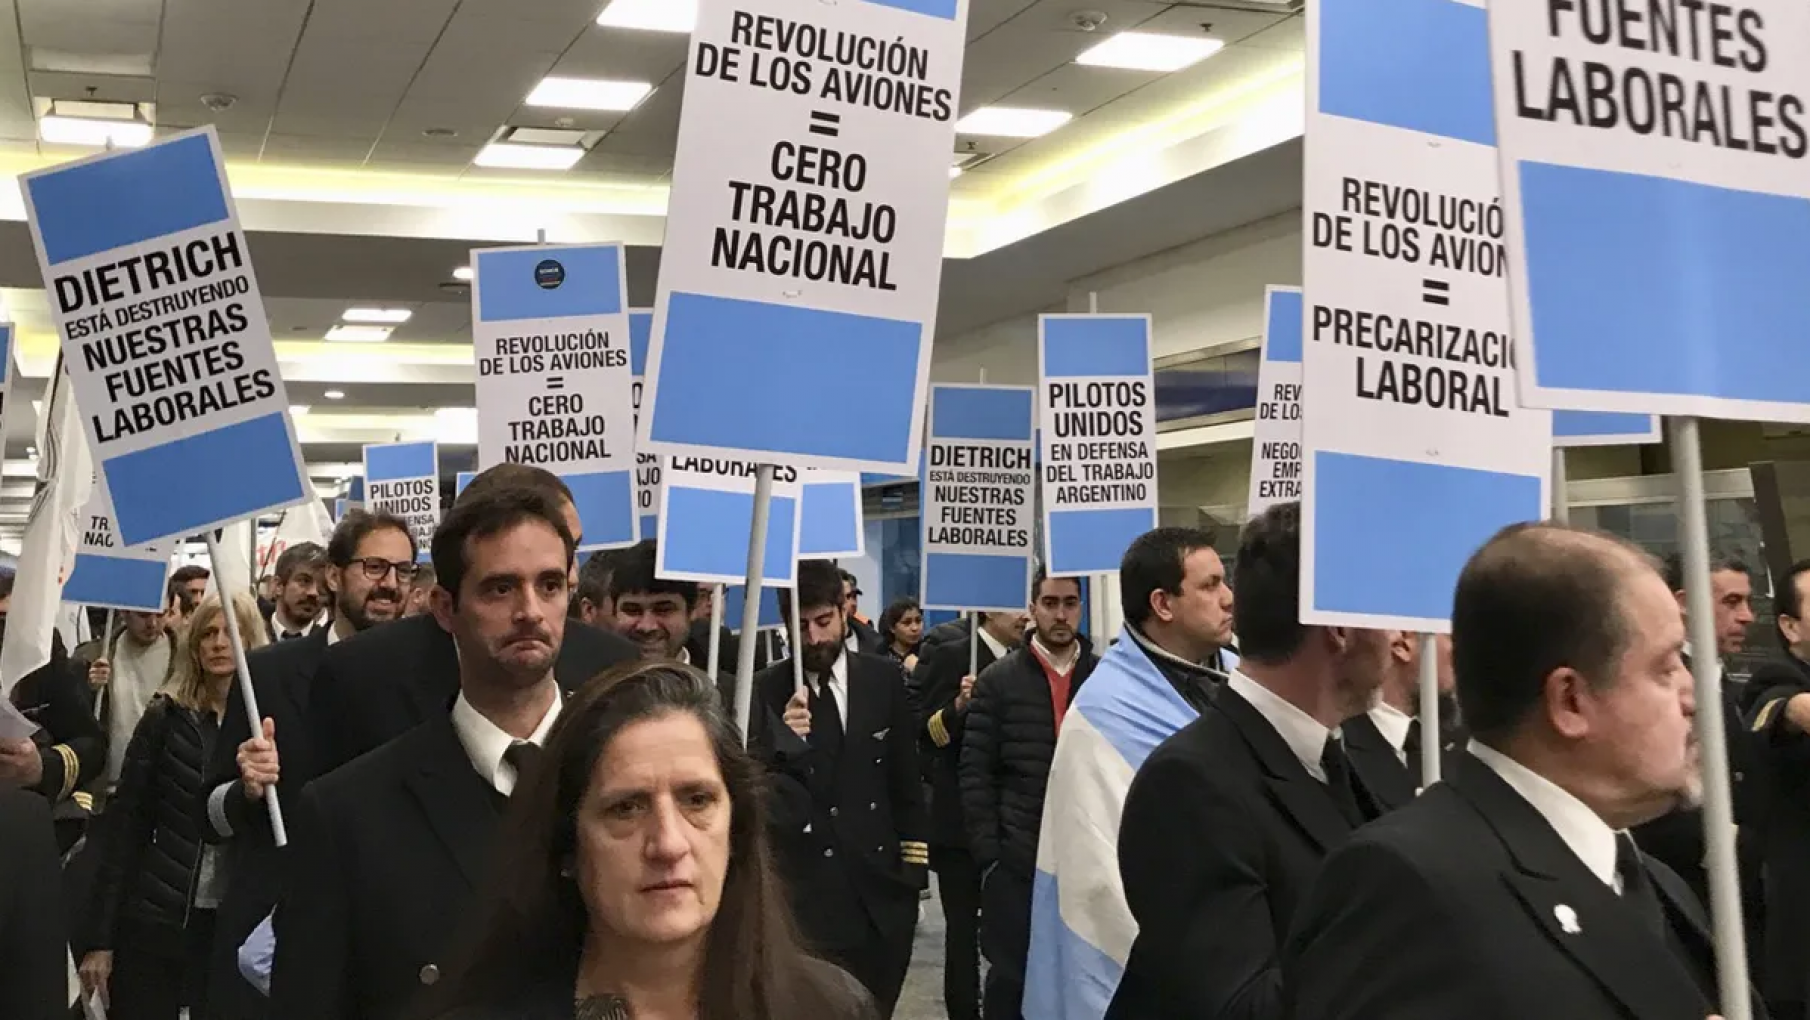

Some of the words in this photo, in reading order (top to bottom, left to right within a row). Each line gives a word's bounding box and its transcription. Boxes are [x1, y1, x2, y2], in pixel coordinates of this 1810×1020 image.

[731, 10, 929, 81] REVOLUCIÓN
[1547, 0, 1767, 73] FUENTES
[695, 42, 741, 82] DE
[749, 52, 812, 95] LOS
[820, 67, 952, 122] AVIONES
[1512, 50, 1808, 159] LABORALES
[771, 141, 867, 193] CERO
[729, 180, 896, 244] TRABAJO
[1313, 212, 1352, 251] DE
[1364, 221, 1420, 263] LOS
[54, 231, 243, 314] DIETRICH
[711, 227, 897, 291] NACIONAL
[65, 308, 113, 340] ESTÁ
[115, 275, 249, 326] DESTRUYENDO
[82, 303, 248, 372] NUESTRAS
[495, 328, 609, 355] REVOLUCIÓN
[105, 341, 244, 403] FUENTES
[480, 357, 503, 376] DE
[510, 354, 544, 373] LOS
[550, 349, 627, 371] AVIONES
[1049, 381, 1147, 408] PILOTOS
[1356, 356, 1509, 418] LABORAL
[92, 369, 275, 444] LABORALES
[528, 393, 583, 417] CERO
[1260, 402, 1278, 420] DE
[1282, 403, 1302, 420] LO
[508, 415, 605, 441] TRABAJO
[1054, 410, 1143, 438] UNIDOS
[505, 438, 611, 464] NACIONAL
[930, 445, 1031, 469] DIETRICH
[1051, 444, 1072, 462] EN
[1077, 441, 1148, 460] DEFENSA
[1261, 442, 1302, 460] NEGO
[671, 456, 797, 483] LABORAES
[929, 469, 955, 482] ESTÁ
[957, 471, 1031, 485] DESTRUYENDO
[1047, 464, 1077, 483] DEL
[1082, 462, 1153, 481] TRABAJO
[370, 479, 434, 499] PILOTOS
[935, 485, 1025, 506] NUESTRAS
[1056, 484, 1146, 504] ARGENTINO
[91, 515, 110, 530] TR
[941, 507, 1017, 526] FUENTES
[928, 526, 1028, 548] LABORALES
